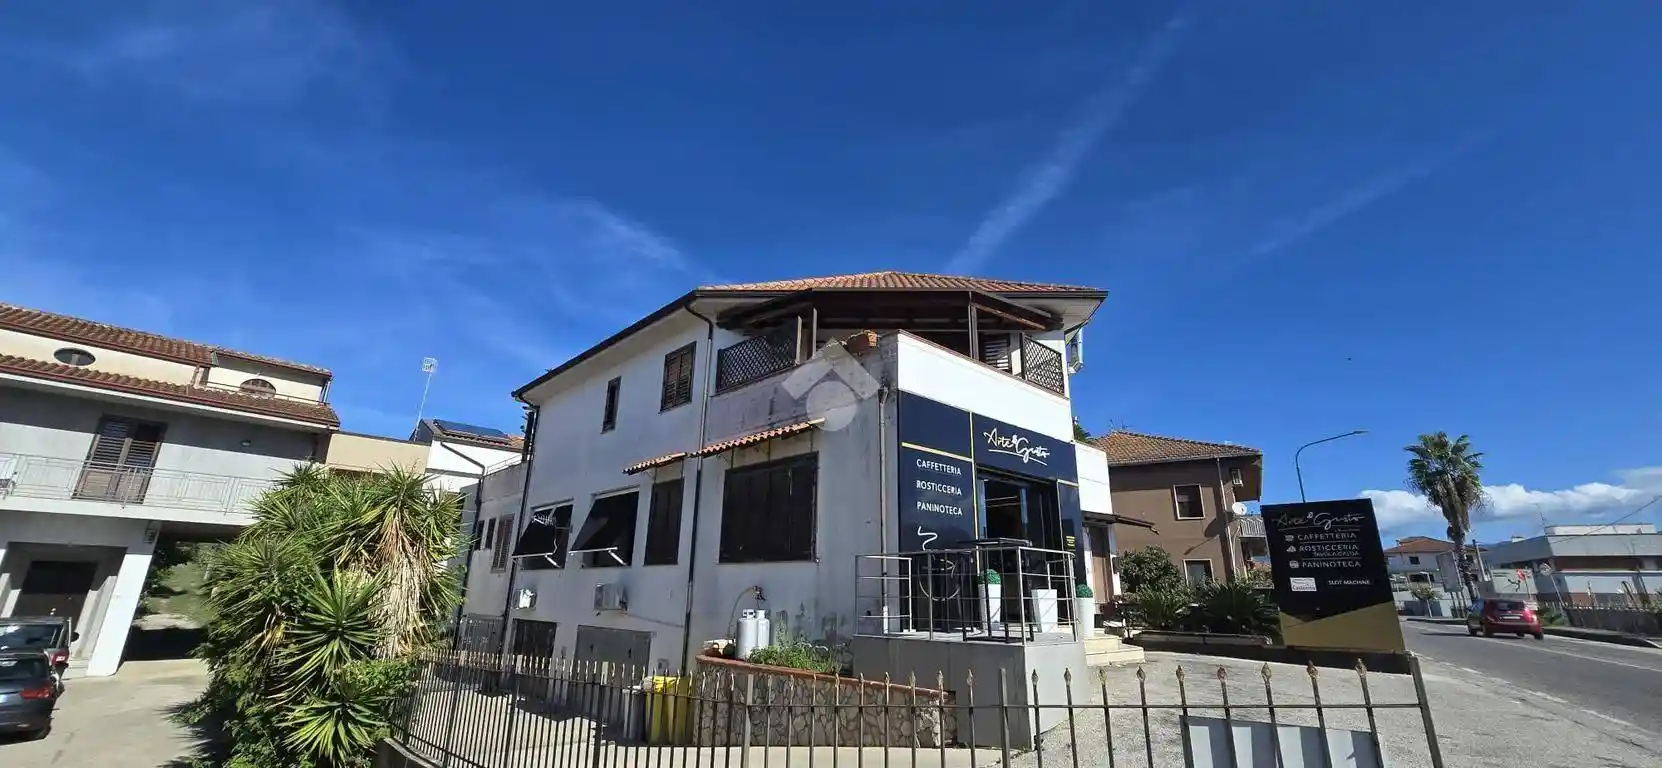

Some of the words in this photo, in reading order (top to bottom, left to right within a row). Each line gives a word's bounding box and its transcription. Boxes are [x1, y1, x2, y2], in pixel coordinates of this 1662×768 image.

[916, 458, 962, 475] CAFFETTERIA
[916, 480, 962, 496] ROSTICCERIA
[917, 501, 963, 516] PANINOTECA
[1297, 532, 1357, 541] CAFFETTERIA
[1299, 544, 1359, 552] ROSTICCERIA
